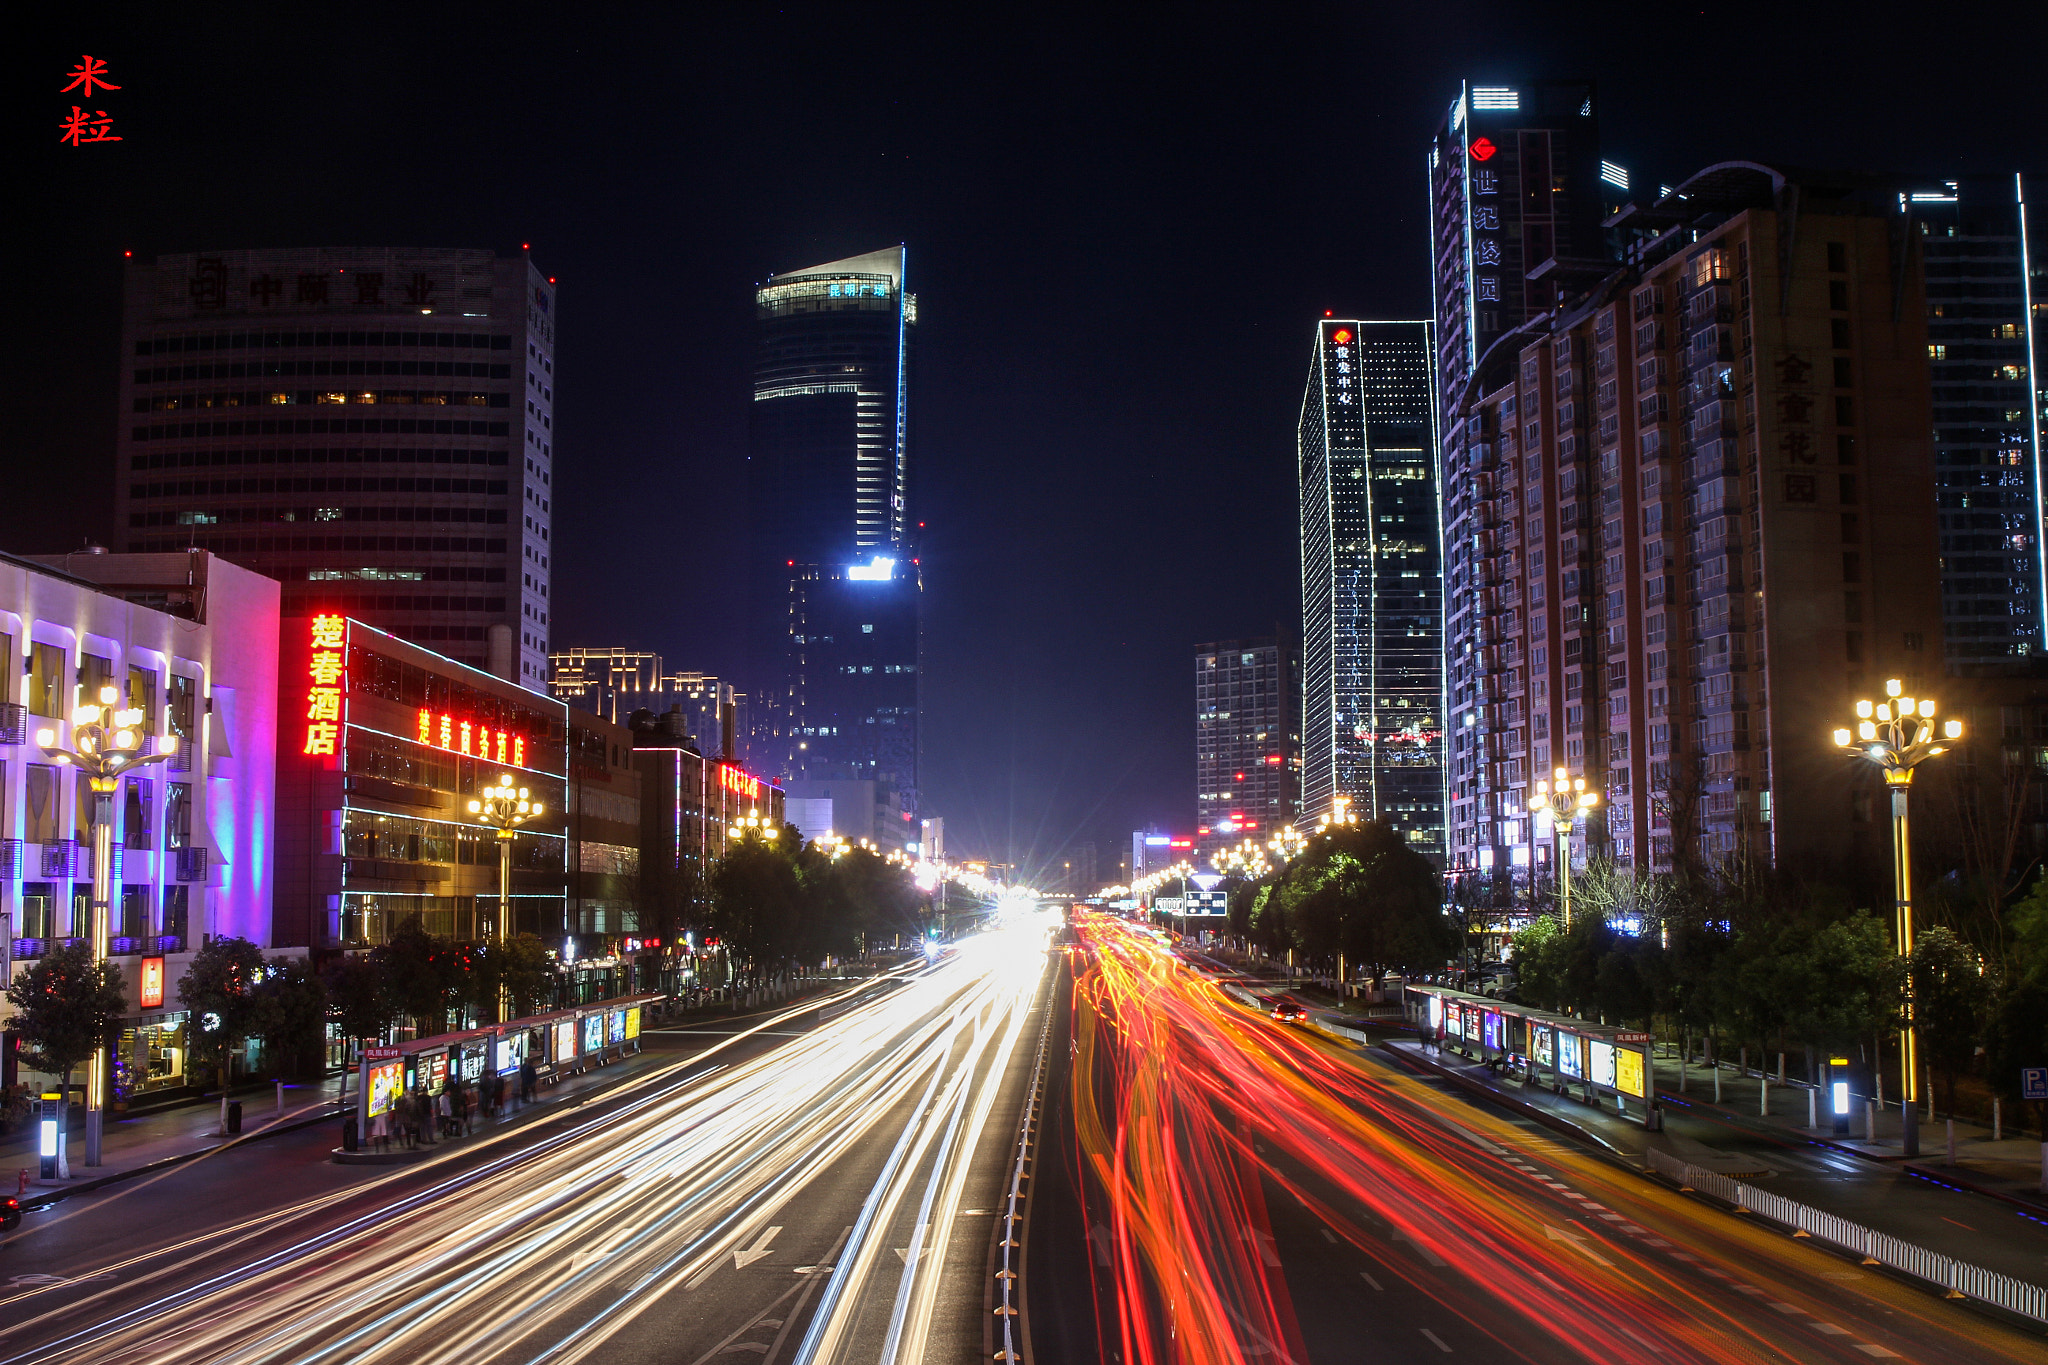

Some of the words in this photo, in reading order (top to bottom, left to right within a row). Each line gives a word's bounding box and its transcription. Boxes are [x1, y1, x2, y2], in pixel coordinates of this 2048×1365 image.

[1472, 168, 1502, 302] 世纪俊园
[829, 283, 886, 297] 昆明广场
[1336, 345, 1353, 405] 俊发中心
[1774, 353, 1817, 503] 金童花园
[303, 613, 345, 756] 楚春酒店
[417, 708, 525, 768] 楚春商务酒店
[366, 1049, 400, 1057] 凤凰新村
[2026, 1070, 2041, 1091] P
